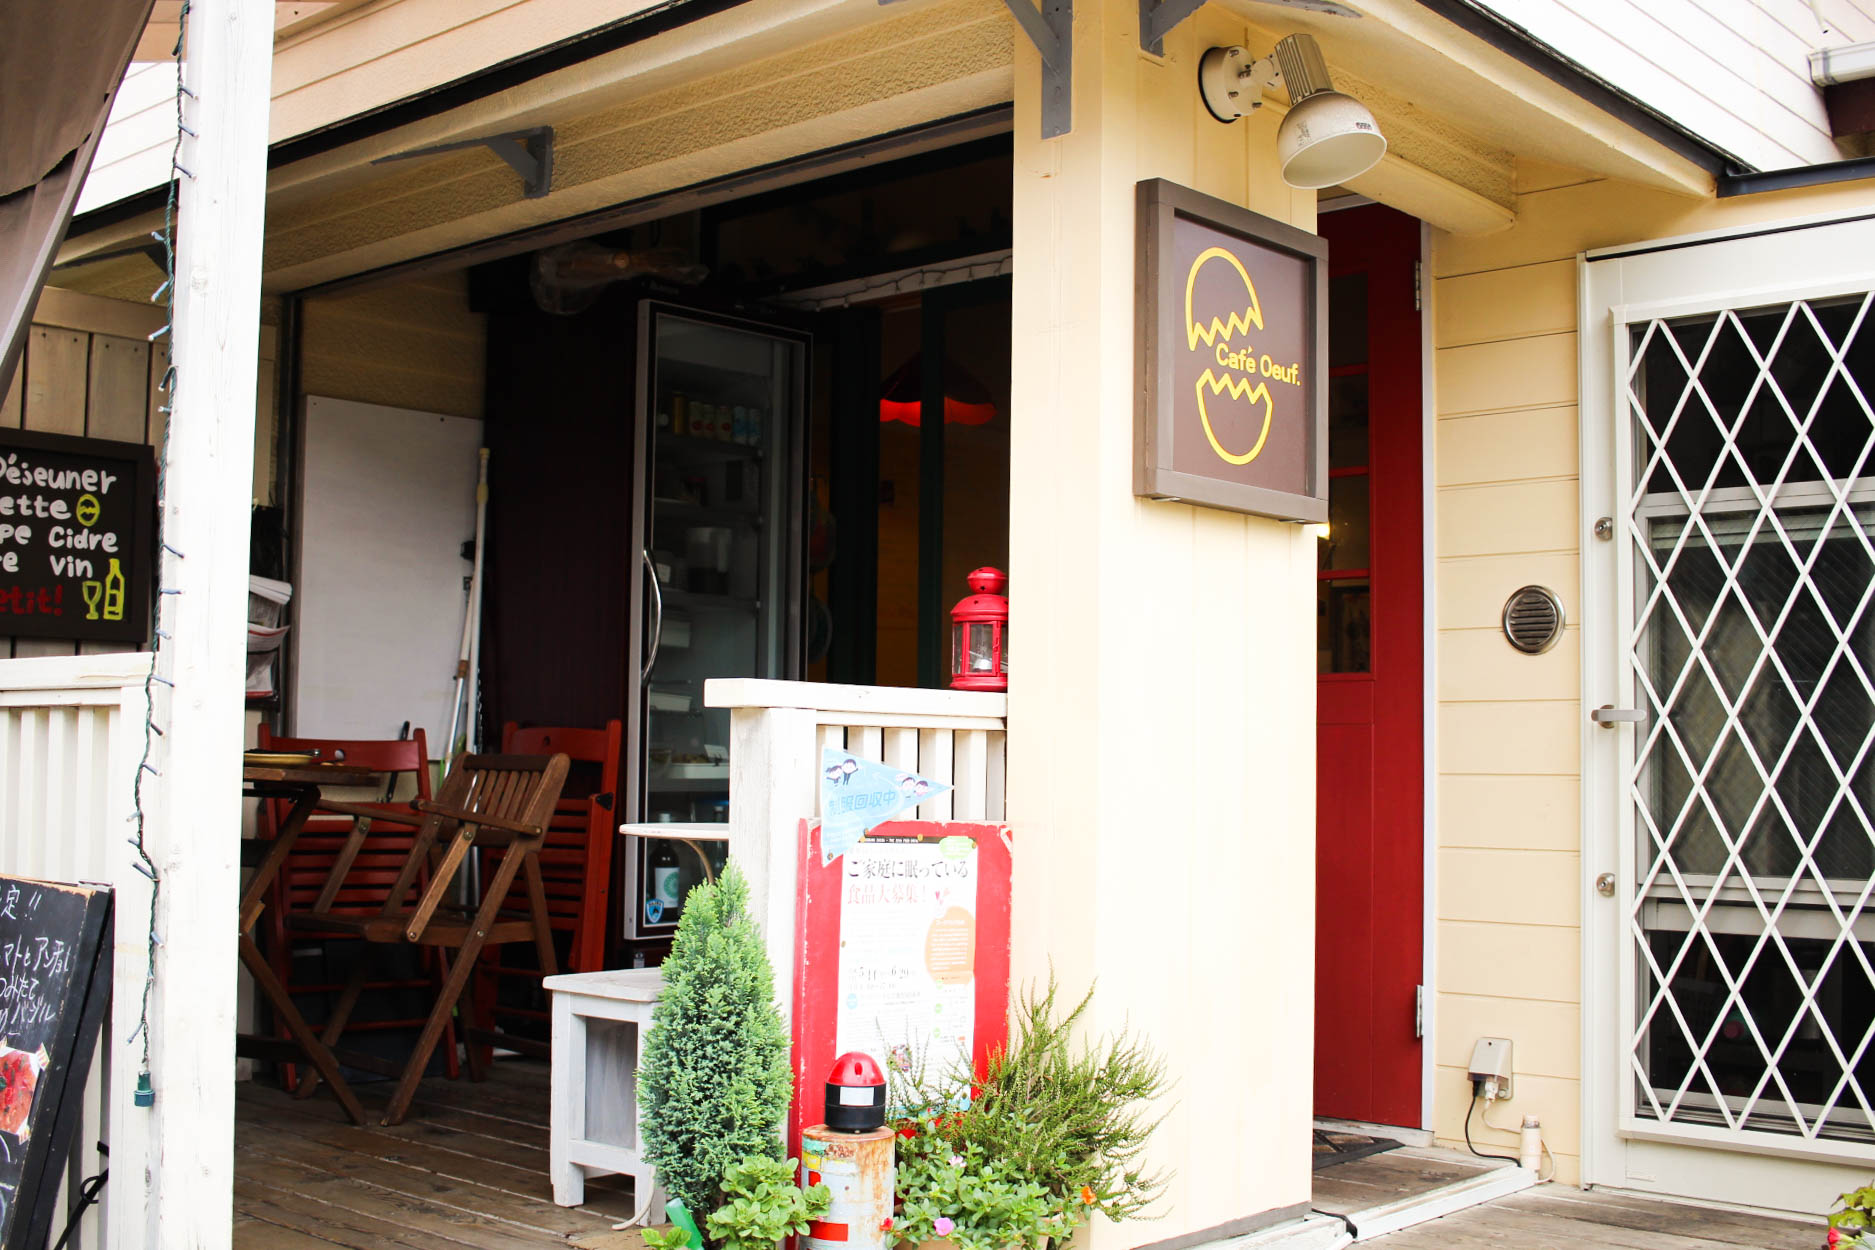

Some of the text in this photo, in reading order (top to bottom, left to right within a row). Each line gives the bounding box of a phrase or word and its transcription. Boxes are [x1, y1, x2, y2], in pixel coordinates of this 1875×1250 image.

[1215, 343, 1257, 374] Café
[48, 525, 119, 553] Cidre
[848, 858, 969, 879] ご家庭に眠っている
